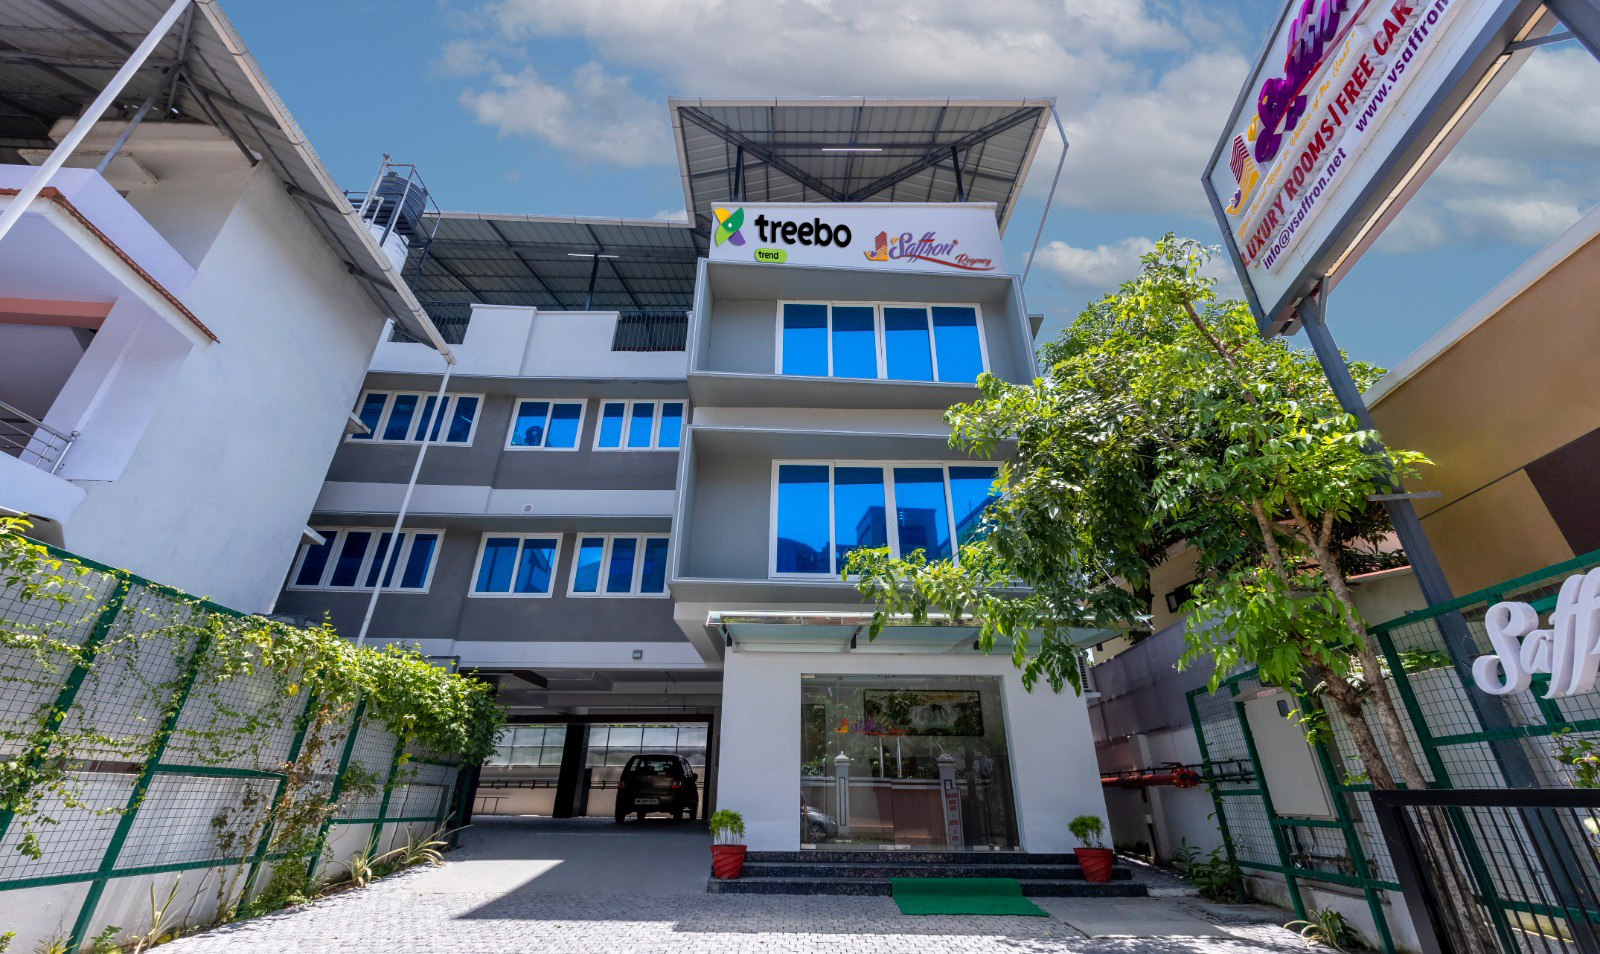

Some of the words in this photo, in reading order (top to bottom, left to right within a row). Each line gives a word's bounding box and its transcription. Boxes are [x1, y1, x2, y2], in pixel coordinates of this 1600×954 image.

[755, 214, 852, 248] treebo
[1240, 192, 1285, 268] LUXURY
[1262, 147, 1347, 270] info@vsaffron.net
[758, 250, 779, 260] trend
[888, 231, 955, 264] Saffron
[1472, 567, 1600, 699] Saff
